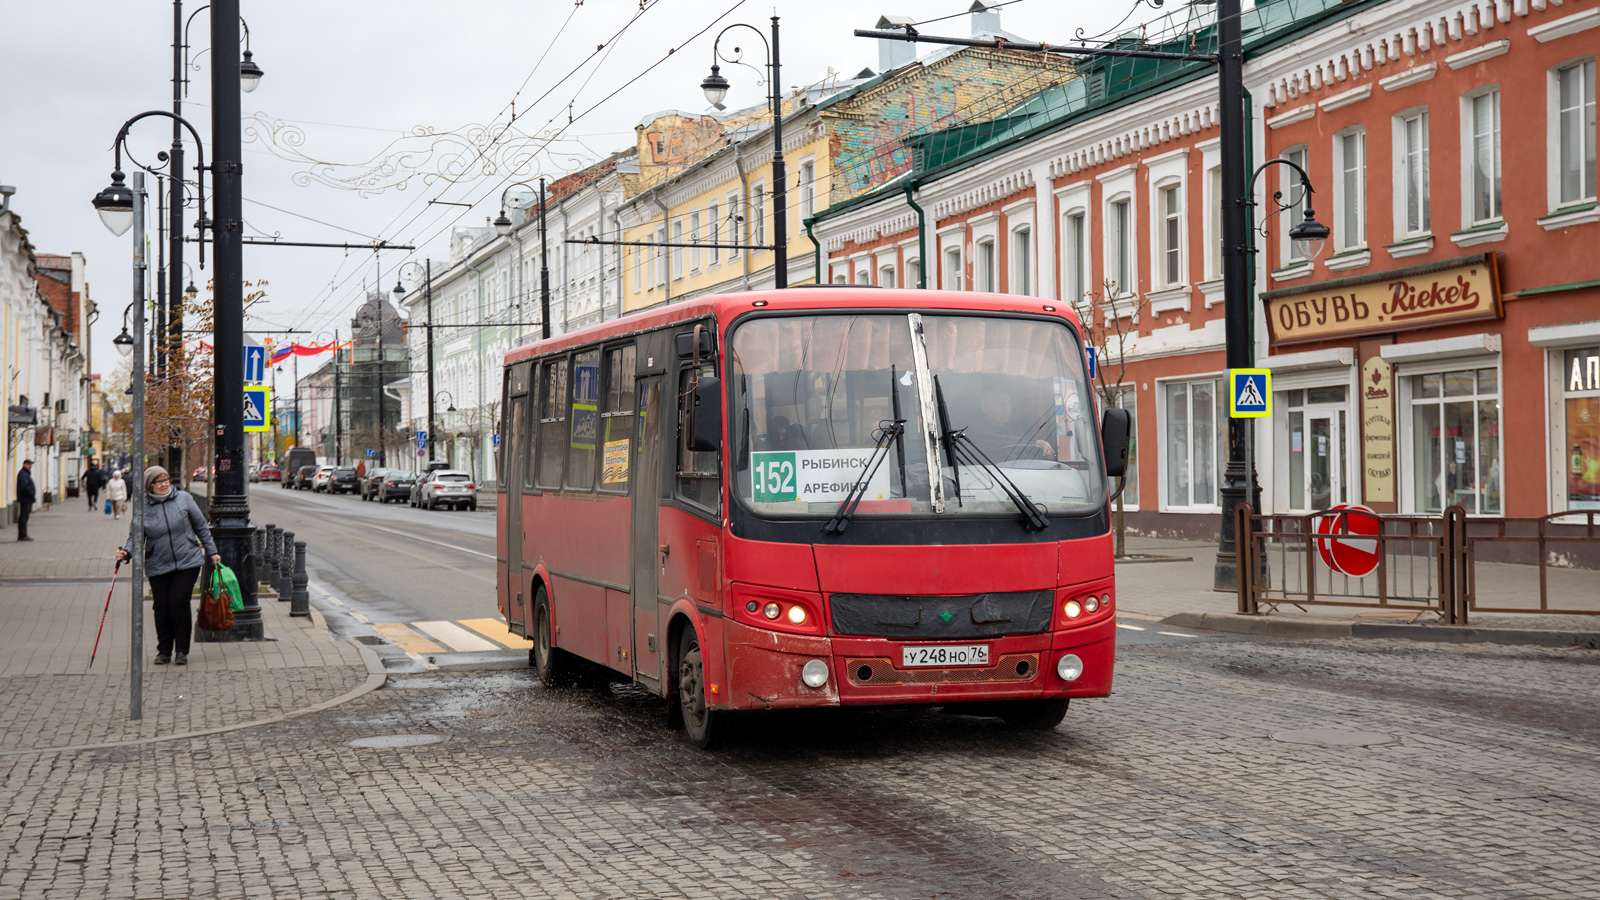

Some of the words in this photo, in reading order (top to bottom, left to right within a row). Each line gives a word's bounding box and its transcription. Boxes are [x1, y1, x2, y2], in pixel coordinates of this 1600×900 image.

[1279, 293, 1369, 331] ОБУВЬ
[1570, 356, 1600, 391] АП
[755, 460, 794, 494] 152
[802, 457, 868, 470] РЫБИНСК
[970, 647, 984, 658] 76
